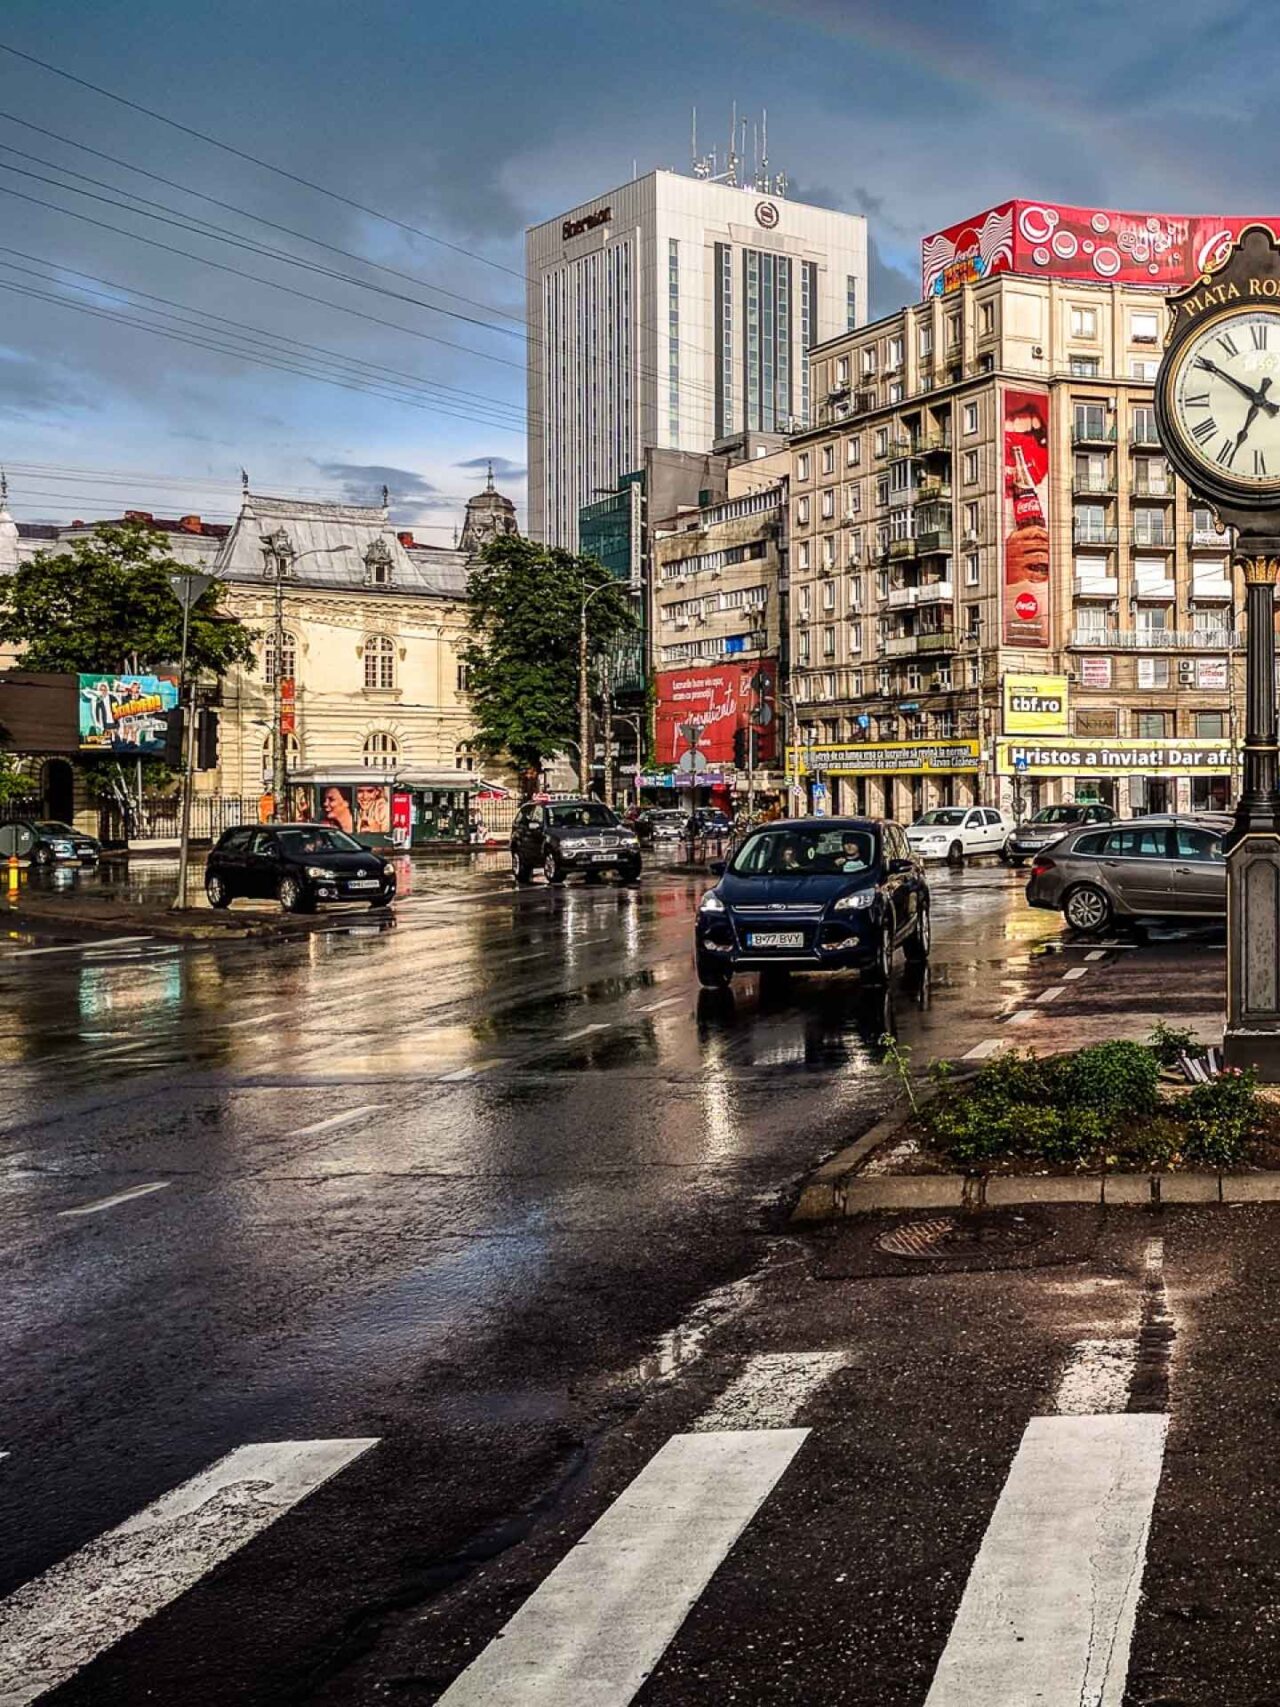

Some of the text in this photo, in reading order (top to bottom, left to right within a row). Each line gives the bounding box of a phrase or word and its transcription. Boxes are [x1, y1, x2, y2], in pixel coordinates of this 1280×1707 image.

[1012, 696, 1060, 712] tbf.ro
[1012, 748, 1080, 765] Hristos
[1085, 752, 1096, 766] a
[1102, 749, 1163, 766] înviat!
[1168, 750, 1203, 765] Dar
